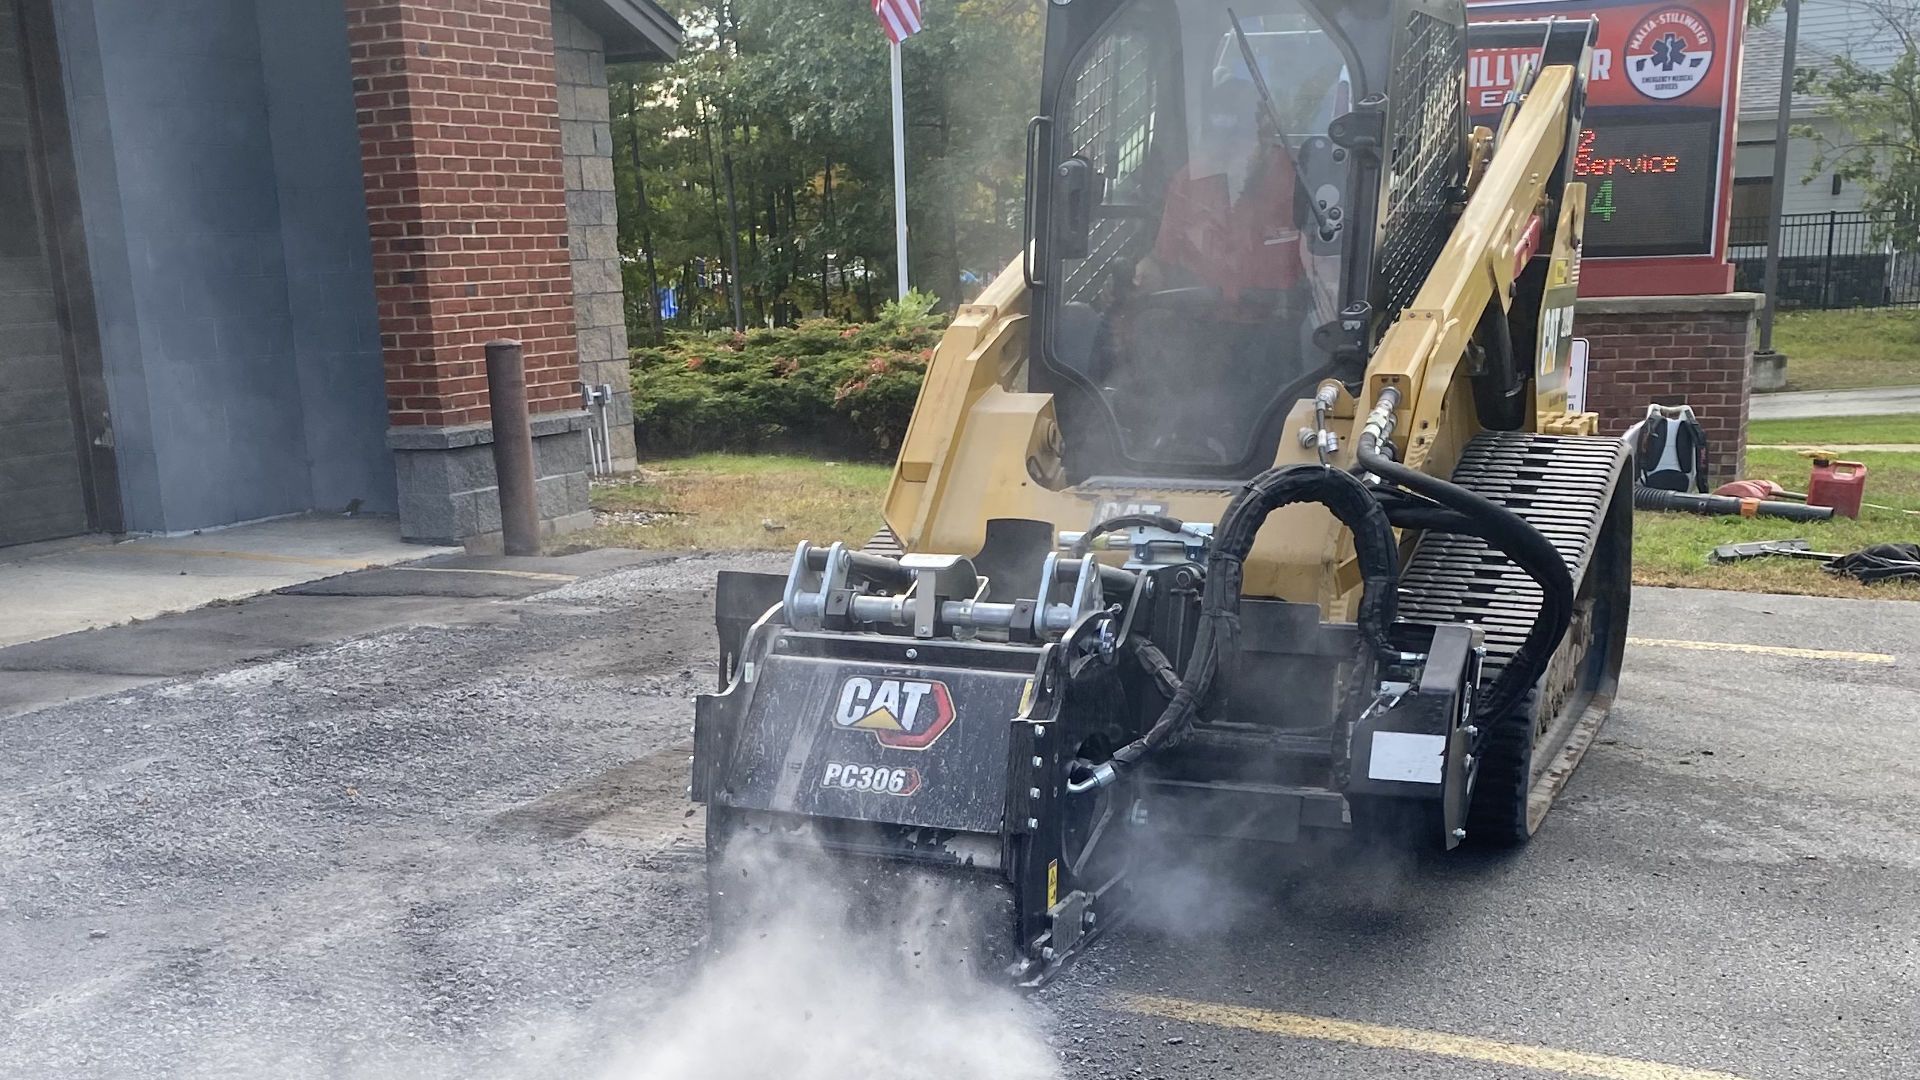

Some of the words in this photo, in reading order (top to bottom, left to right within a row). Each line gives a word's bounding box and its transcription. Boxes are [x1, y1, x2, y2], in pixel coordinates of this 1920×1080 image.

[1631, 12, 1708, 49] MALTA-STILLWATER
[1575, 153, 1679, 175] Service
[1590, 180, 1617, 221] 4
[836, 677, 932, 731] CAT
[823, 763, 906, 792] PC306
